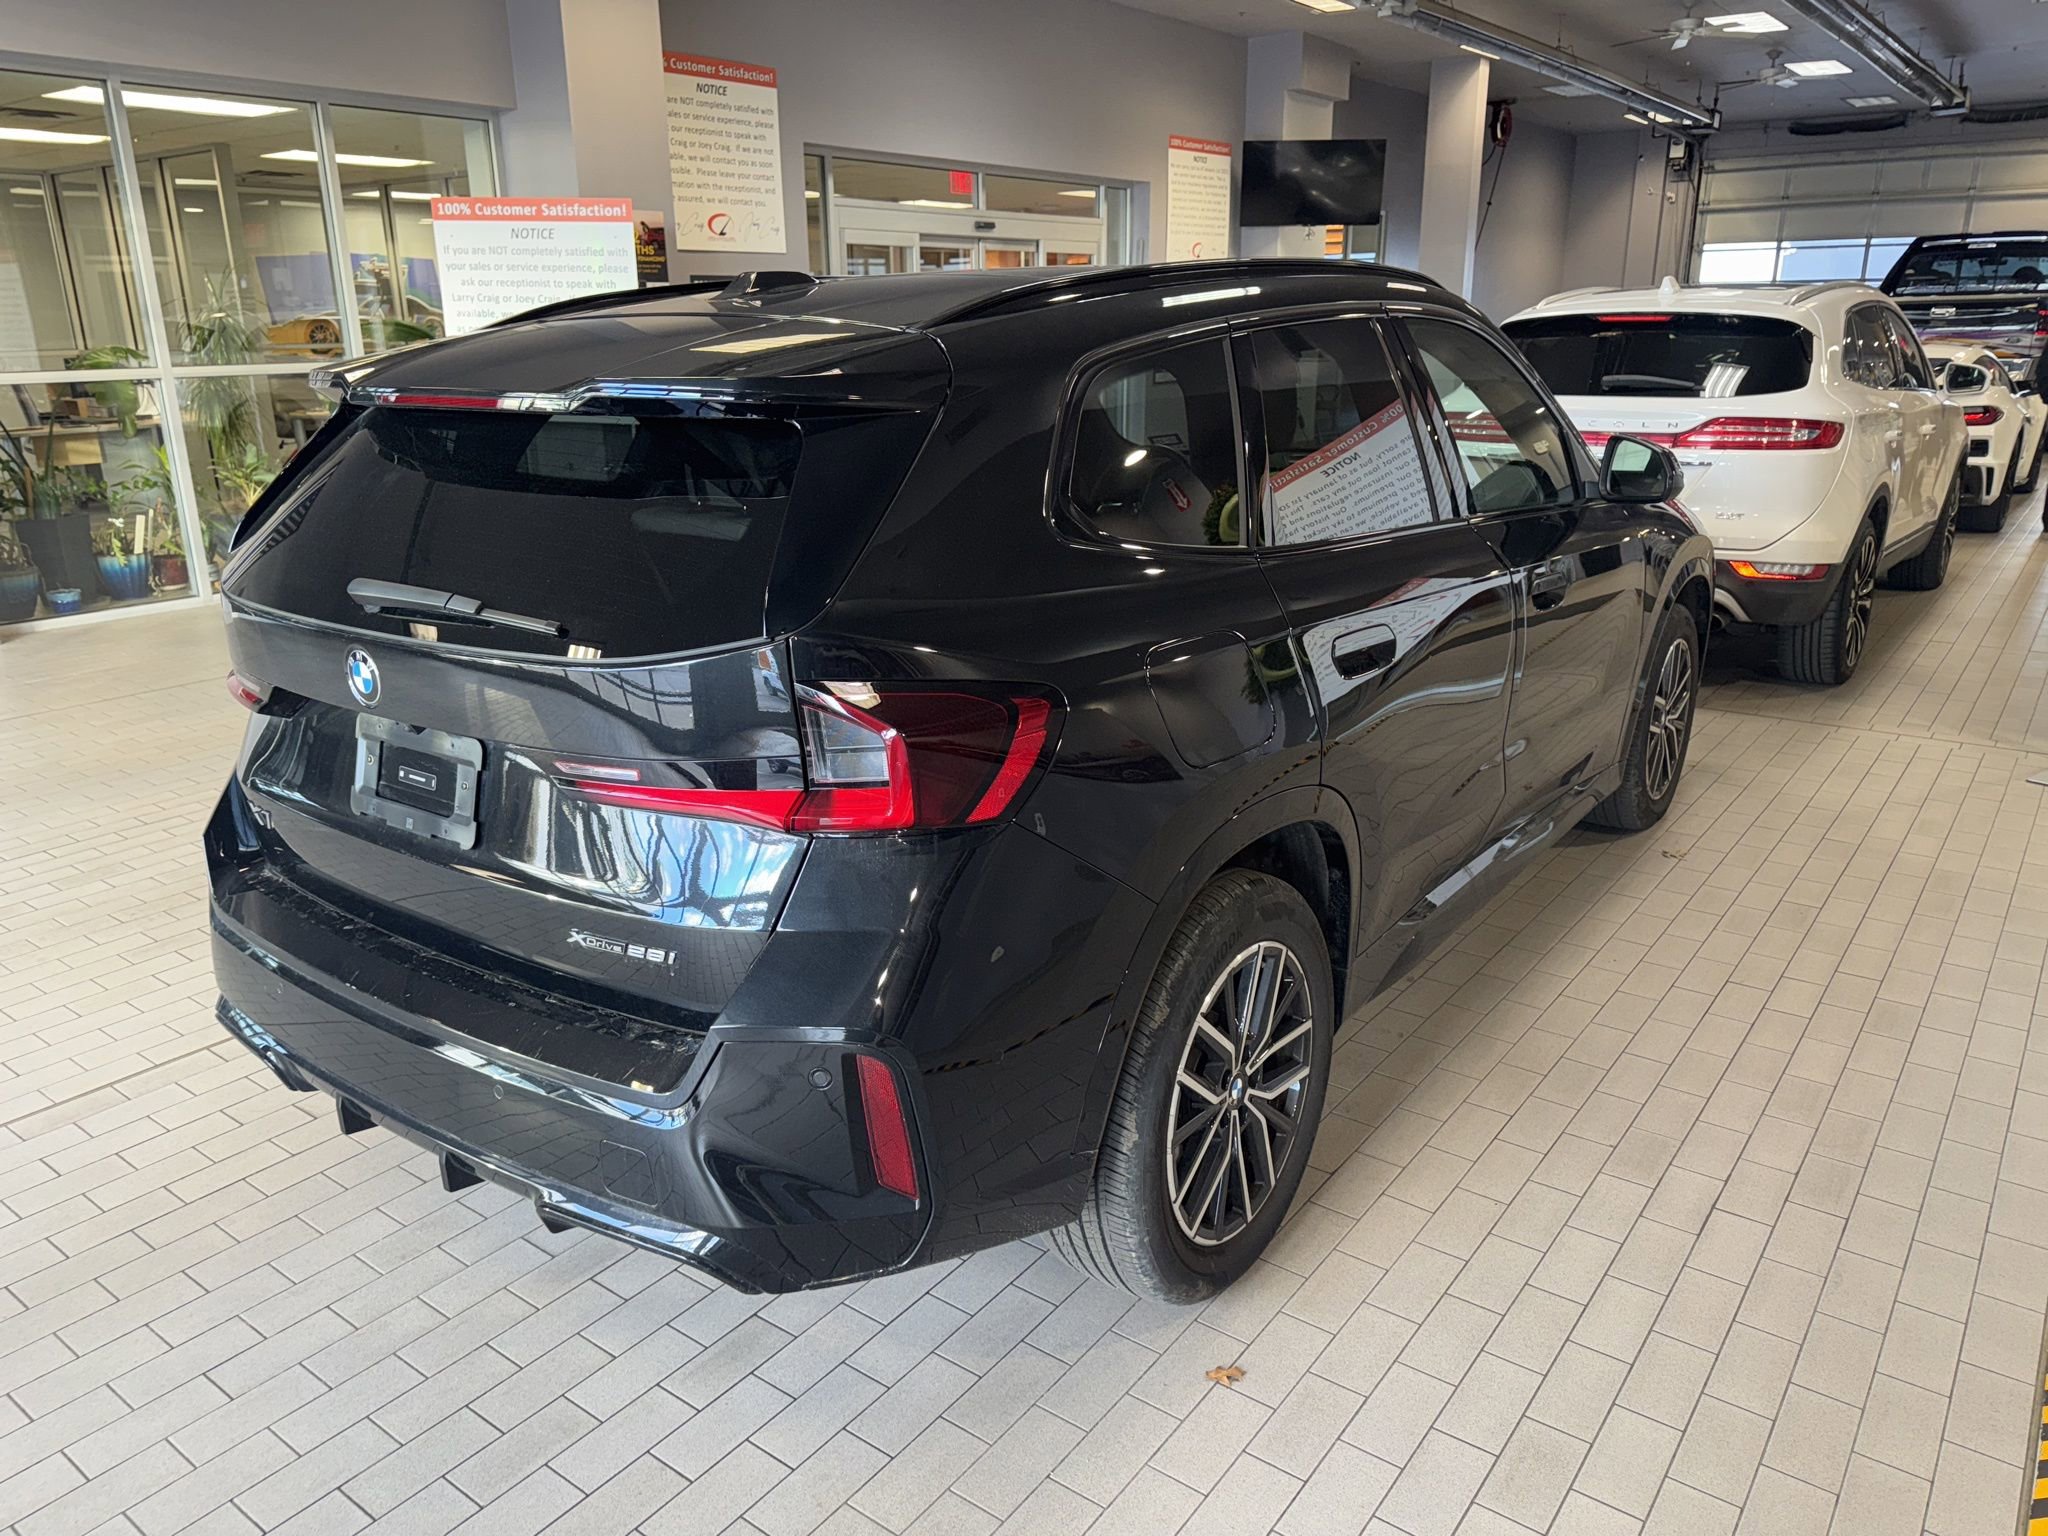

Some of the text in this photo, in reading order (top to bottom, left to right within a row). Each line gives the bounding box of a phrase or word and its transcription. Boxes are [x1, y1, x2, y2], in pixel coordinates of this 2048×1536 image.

[670, 58, 716, 74] Customer
[718, 65, 774, 84] Satisfaction!
[696, 82, 728, 97] NOTICE
[680, 96, 694, 106] NOT
[696, 99, 732, 112] completely
[733, 103, 759, 114] satisfied
[761, 107, 774, 116] with
[692, 112, 715, 123] service
[754, 120, 774, 130] please
[671, 125, 683, 133] our
[685, 126, 724, 138] receptionist
[733, 132, 751, 141] speak
[753, 133, 766, 141] with
[670, 137, 688, 149] Craig
[712, 156, 736, 165] contact
[737, 160, 750, 168] you
[696, 167, 718, 177] Please
[719, 169, 736, 179] leave
[752, 173, 774, 182] contact
[696, 182, 710, 190] with
[712, 183, 723, 191] the
[730, 199, 753, 207] contact
[437, 202, 627, 218] 100% Customer Satisfaction!
[510, 228, 555, 240] NOTICE
[444, 245, 628, 258] If you are NOT completely satisfied with
[636, 244, 655, 256] THS
[445, 263, 466, 273] your
[469, 261, 491, 271] sales
[506, 262, 538, 272] service
[541, 263, 596, 275] experience,
[598, 263, 629, 275] please
[461, 276, 616, 290] ask our receptionist to speak with
[452, 293, 475, 304] Larry
[477, 293, 500, 305] Craig
[502, 295, 512, 303] or
[515, 294, 535, 305] Joey
[456, 308, 498, 319] available,
[1587, 420, 1679, 429] COLN
